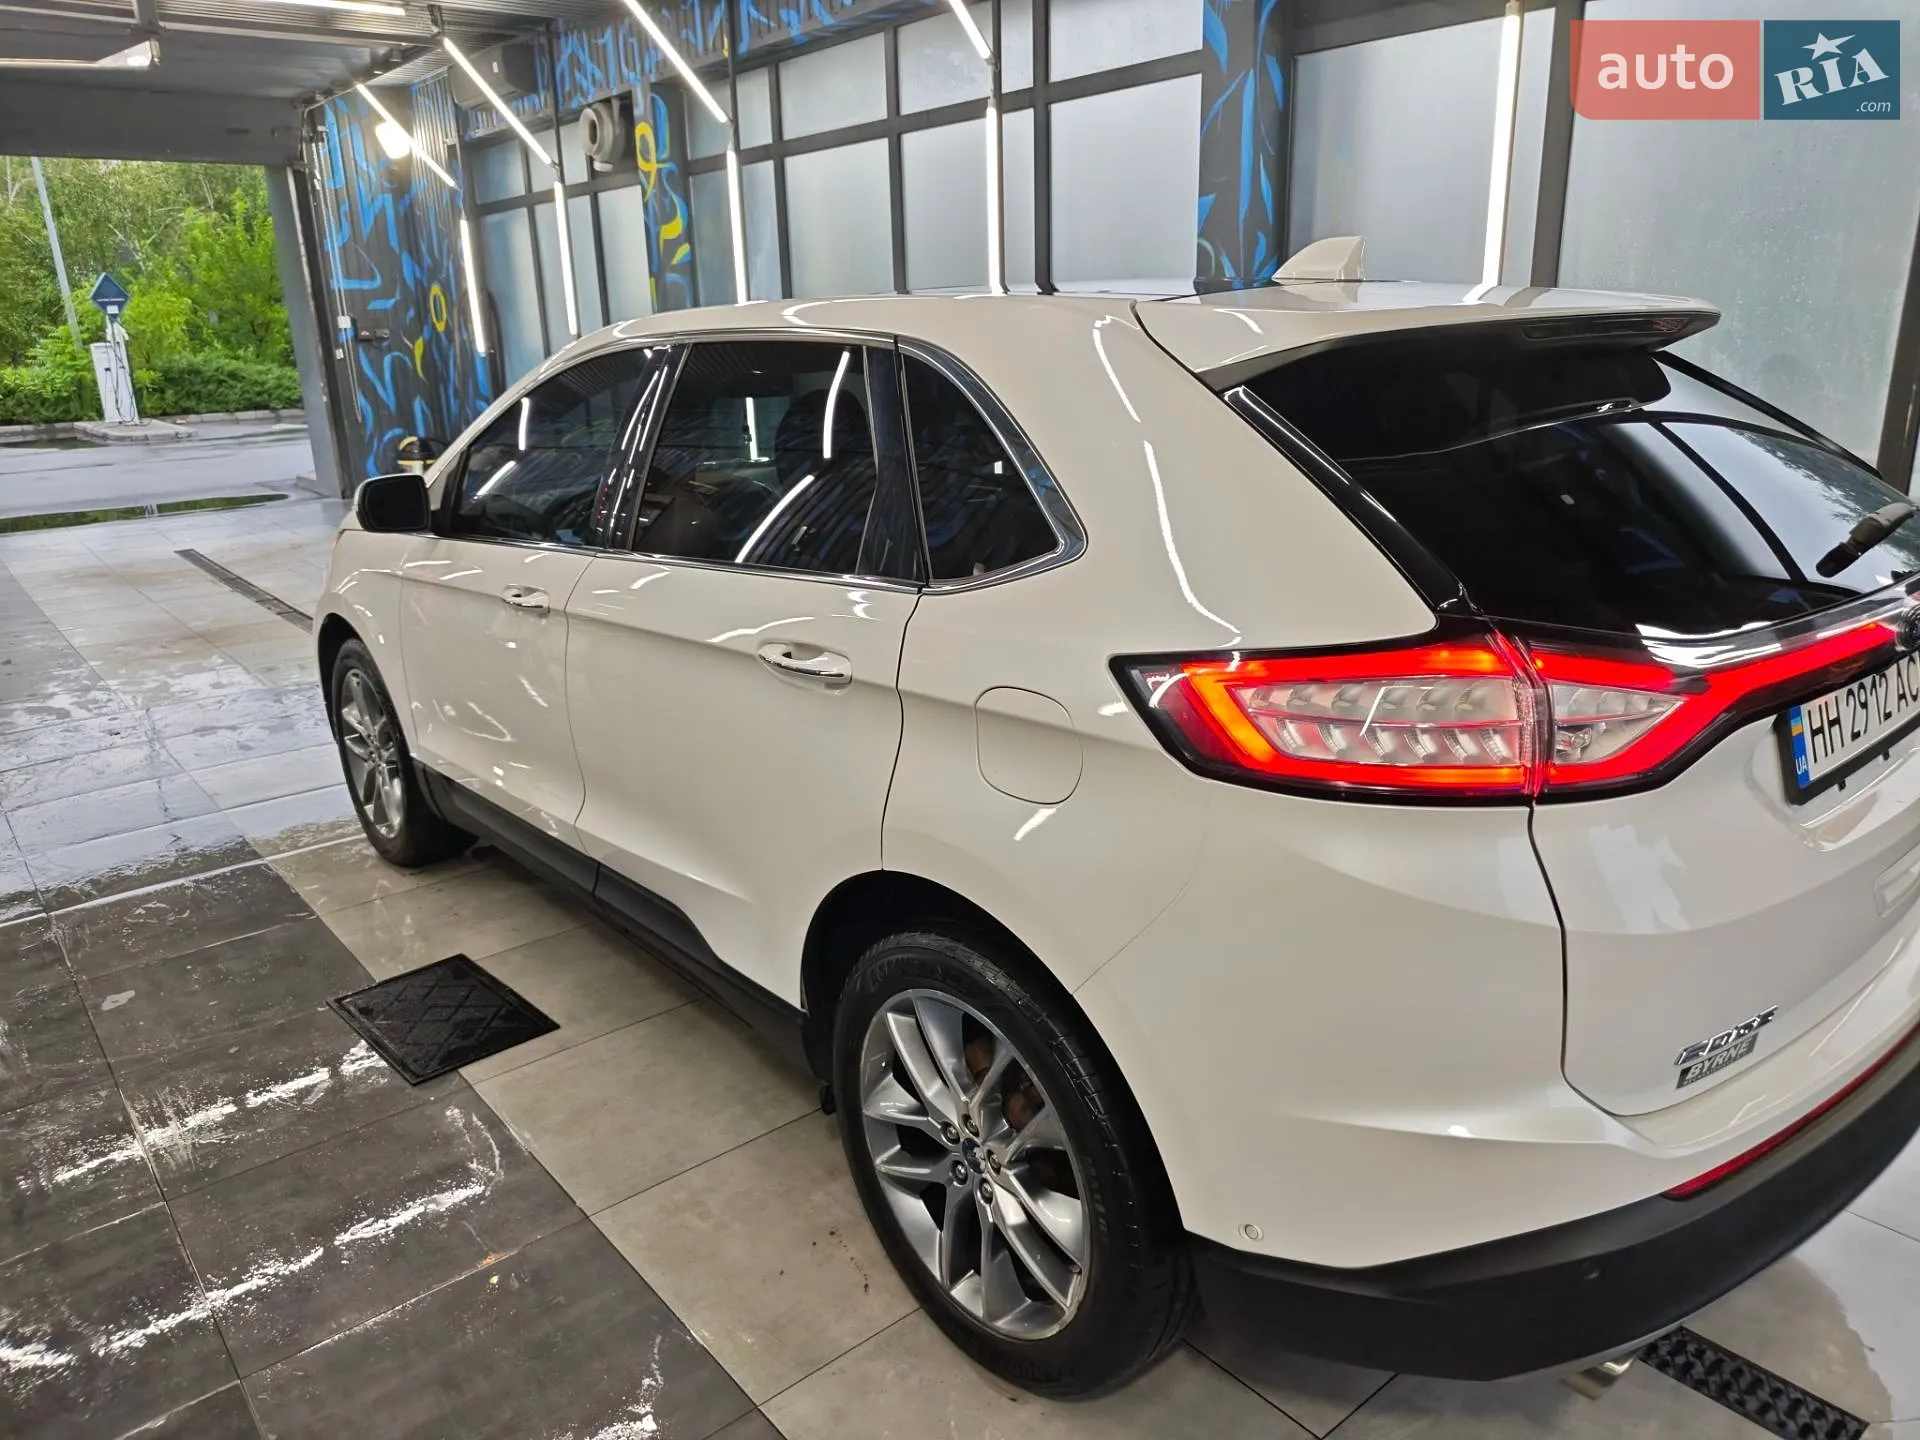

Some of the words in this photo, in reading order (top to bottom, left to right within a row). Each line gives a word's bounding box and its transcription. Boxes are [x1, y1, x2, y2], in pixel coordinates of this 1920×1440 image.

[1807, 696, 1845, 763] HH
[1846, 673, 1892, 741] 2912
[1795, 755, 1809, 774] UA
[1685, 1035, 1754, 1080] BYRNE
